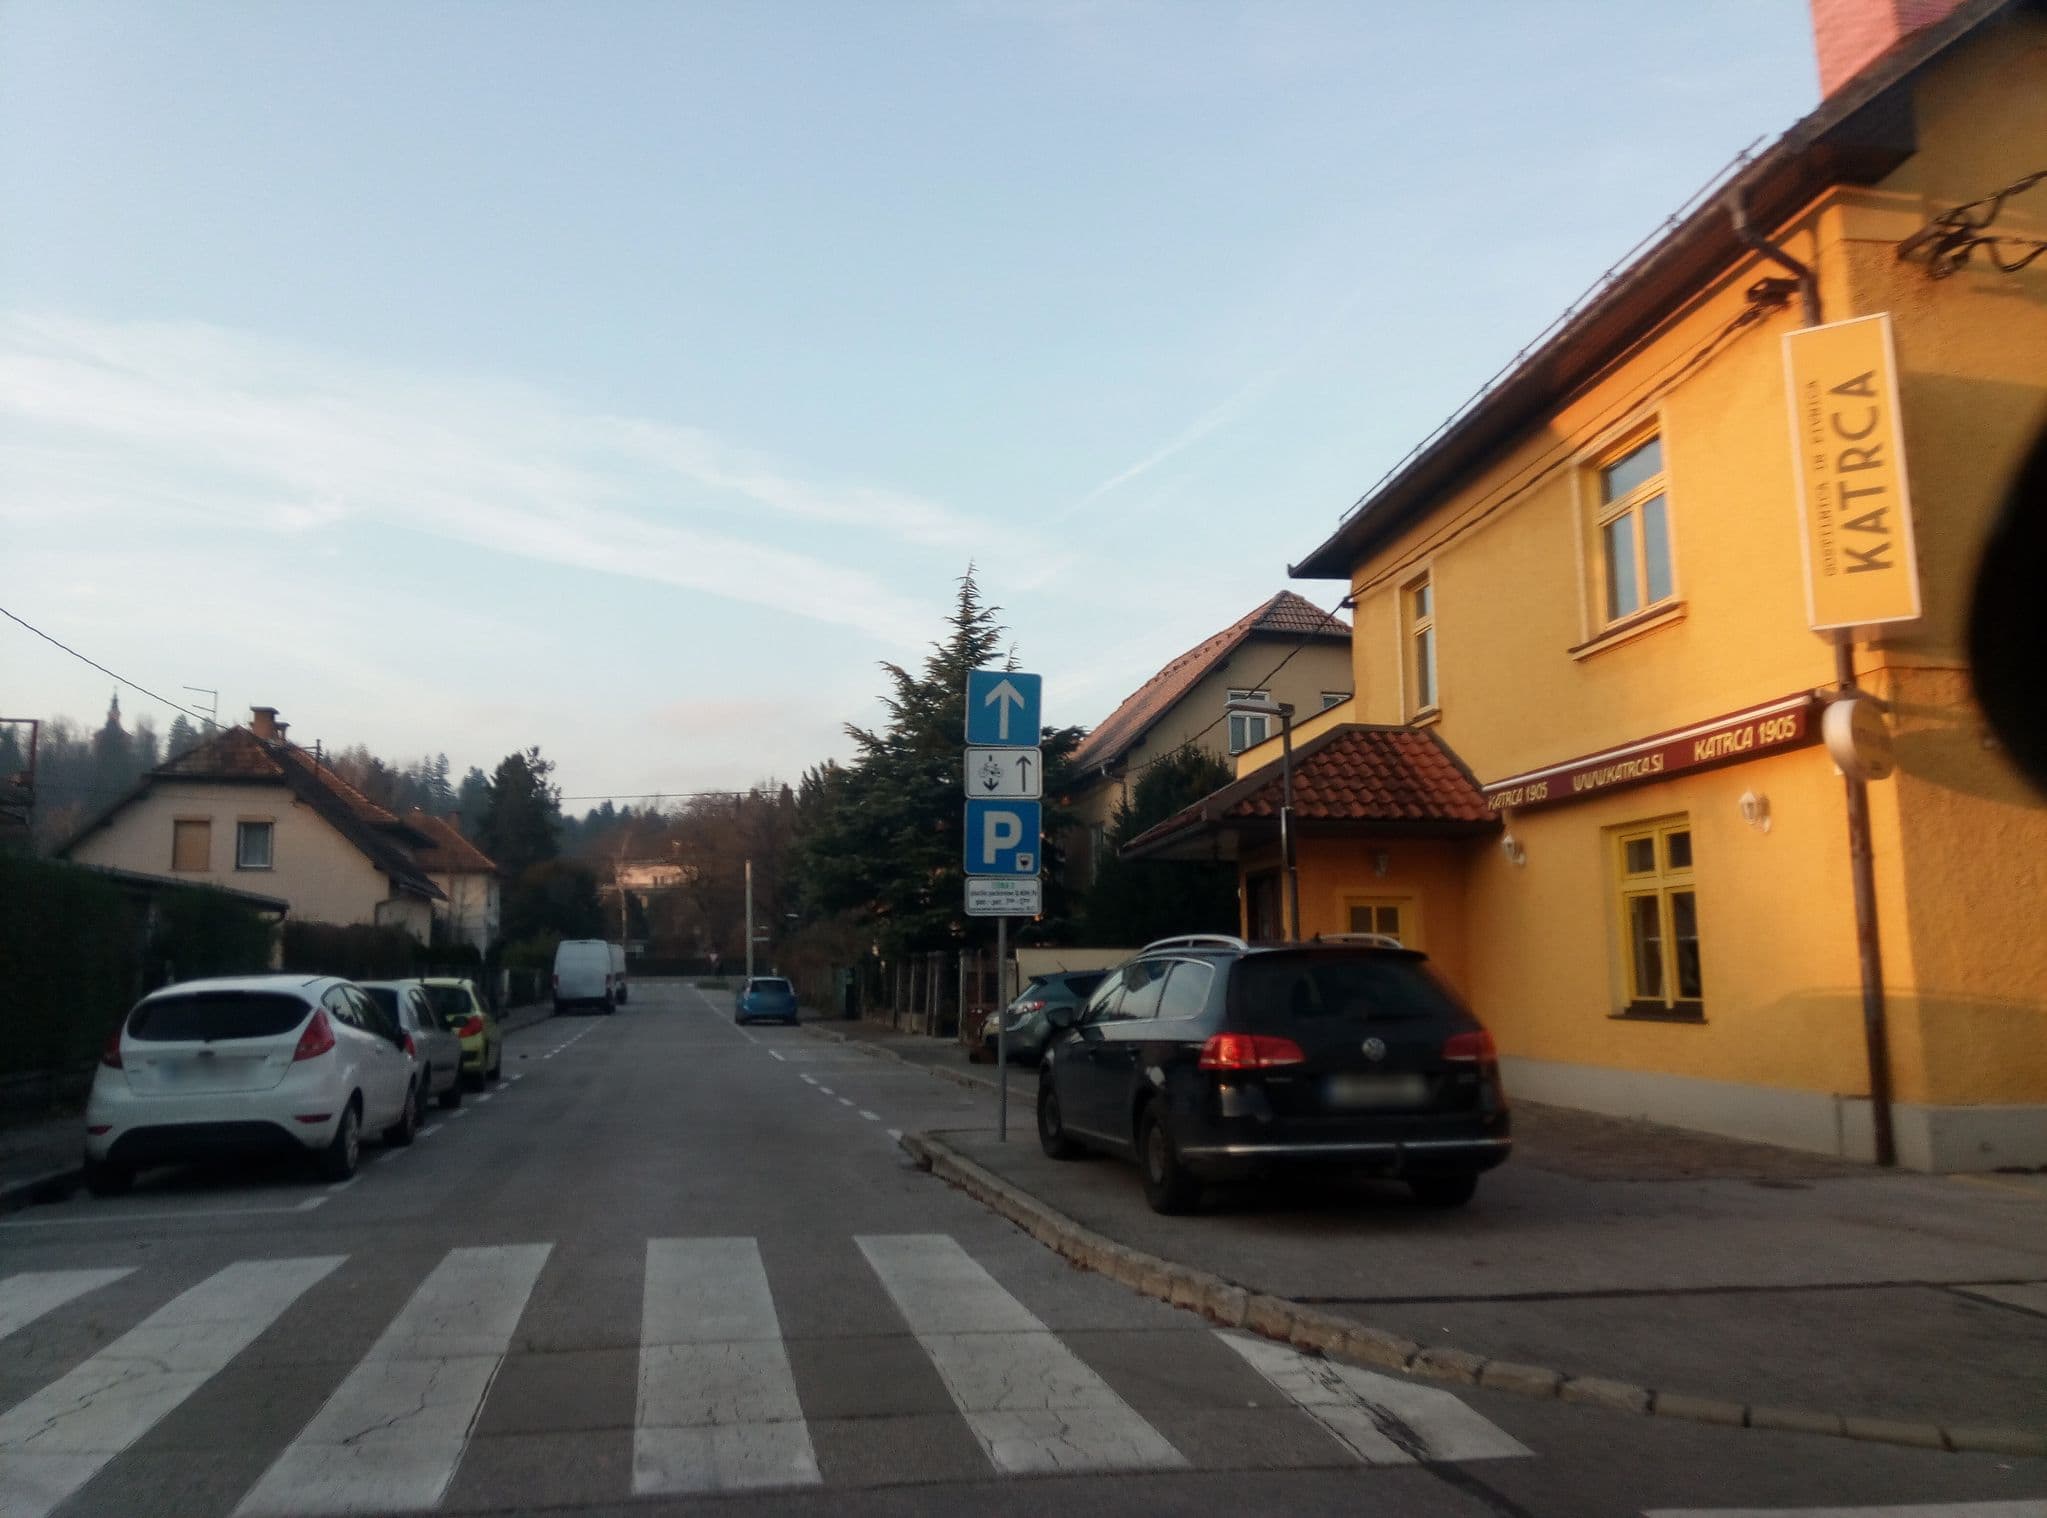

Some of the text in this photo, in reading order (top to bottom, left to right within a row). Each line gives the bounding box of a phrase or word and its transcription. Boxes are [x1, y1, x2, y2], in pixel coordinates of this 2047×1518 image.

[1829, 369, 1893, 574] KATRCA
[1694, 714, 1797, 762] KATRCA 1905
[1488, 782, 1549, 811] KATRCA 1905
[983, 811, 1023, 864] P
